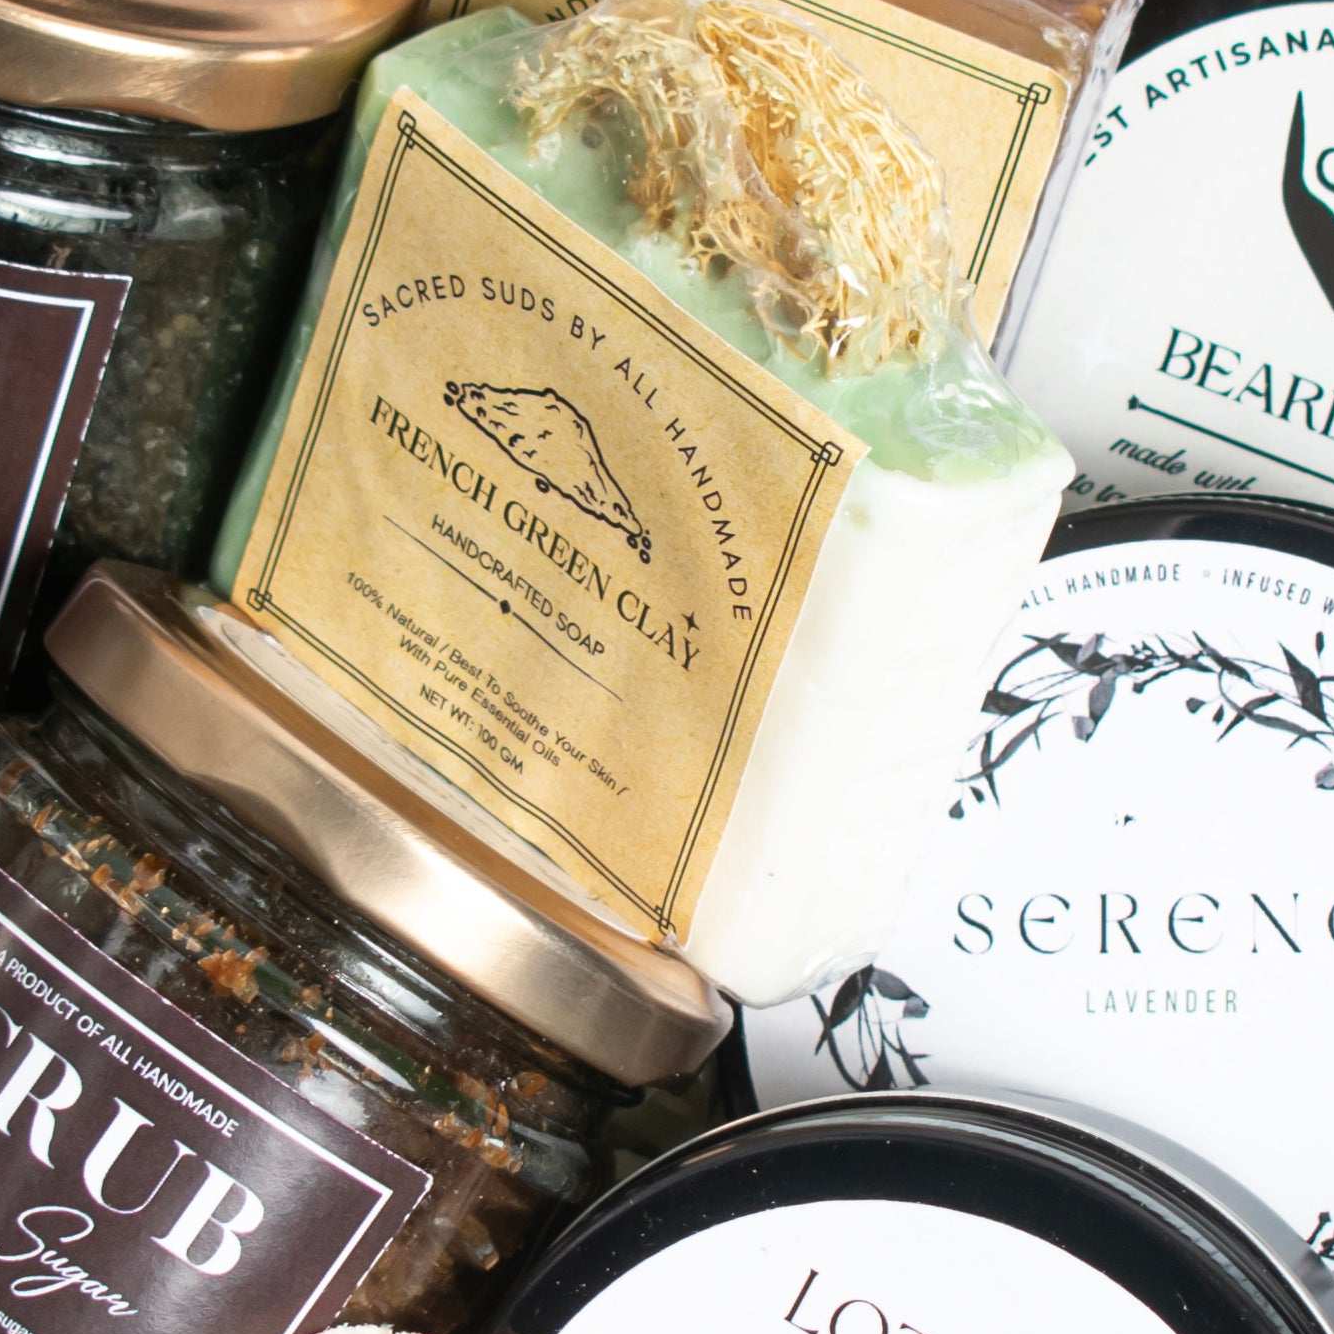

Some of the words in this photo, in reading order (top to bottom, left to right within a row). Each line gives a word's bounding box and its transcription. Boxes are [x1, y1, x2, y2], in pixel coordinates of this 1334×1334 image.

[362, 273, 466, 328] SACRED
[482, 276, 556, 323] SUDS
[569, 313, 607, 353] BY
[614, 355, 658, 411] ALL
[664, 416, 753, 623] HANDMADE
[1108, 436, 1187, 476] made
[369, 394, 499, 513] FRENCH
[503, 499, 613, 597] GREEN
[616, 588, 701, 674] CLAY
[431, 513, 554, 618] HANDCRAFTED
[554, 611, 606, 658] SOAP
[1065, 562, 1182, 595] HANDMADE
[1221, 565, 1313, 607] INFUSED
[346, 571, 385, 610] 100%
[386, 602, 441, 648] Natural
[448, 647, 482, 682] Best
[486, 671, 504, 695] To
[503, 690, 551, 737] Soothe
[553, 729, 588, 764] Your
[587, 756, 619, 791] Skin
[398, 633, 433, 667] With
[432, 659, 469, 693] Pure
[470, 685, 531, 744] Essential
[531, 738, 563, 768] Oils
[419, 682, 449, 712] NET
[476, 723, 499, 753] 100
[499, 745, 526, 774] GM
[4, 955, 79, 1022] PRODUCT
[76, 1012, 106, 1038] OF
[98, 1033, 133, 1065] ALL
[132, 1051, 240, 1139] HANDMADE
[1084, 988, 1240, 1015] LAVENDER
